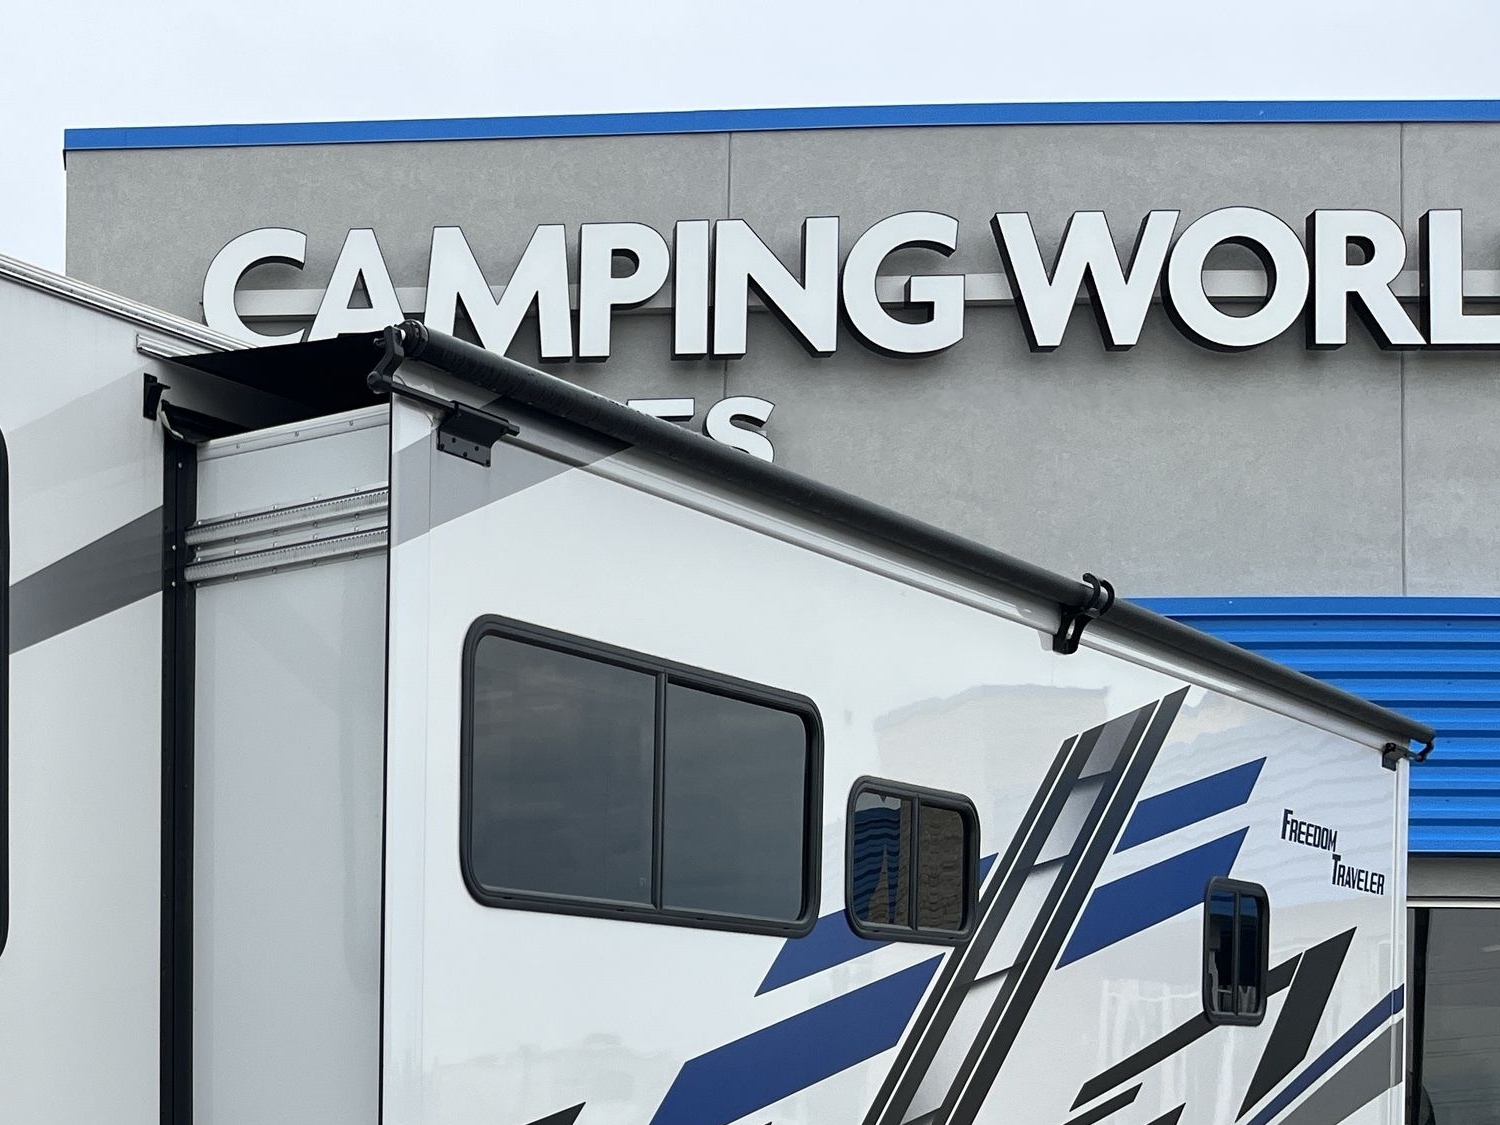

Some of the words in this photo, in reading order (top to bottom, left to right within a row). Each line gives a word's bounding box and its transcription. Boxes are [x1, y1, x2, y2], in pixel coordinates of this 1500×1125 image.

[202, 210, 965, 356] CAMPING
[1281, 808, 1338, 852] FREEDOM
[1331, 854, 1385, 895] TRAVELER
